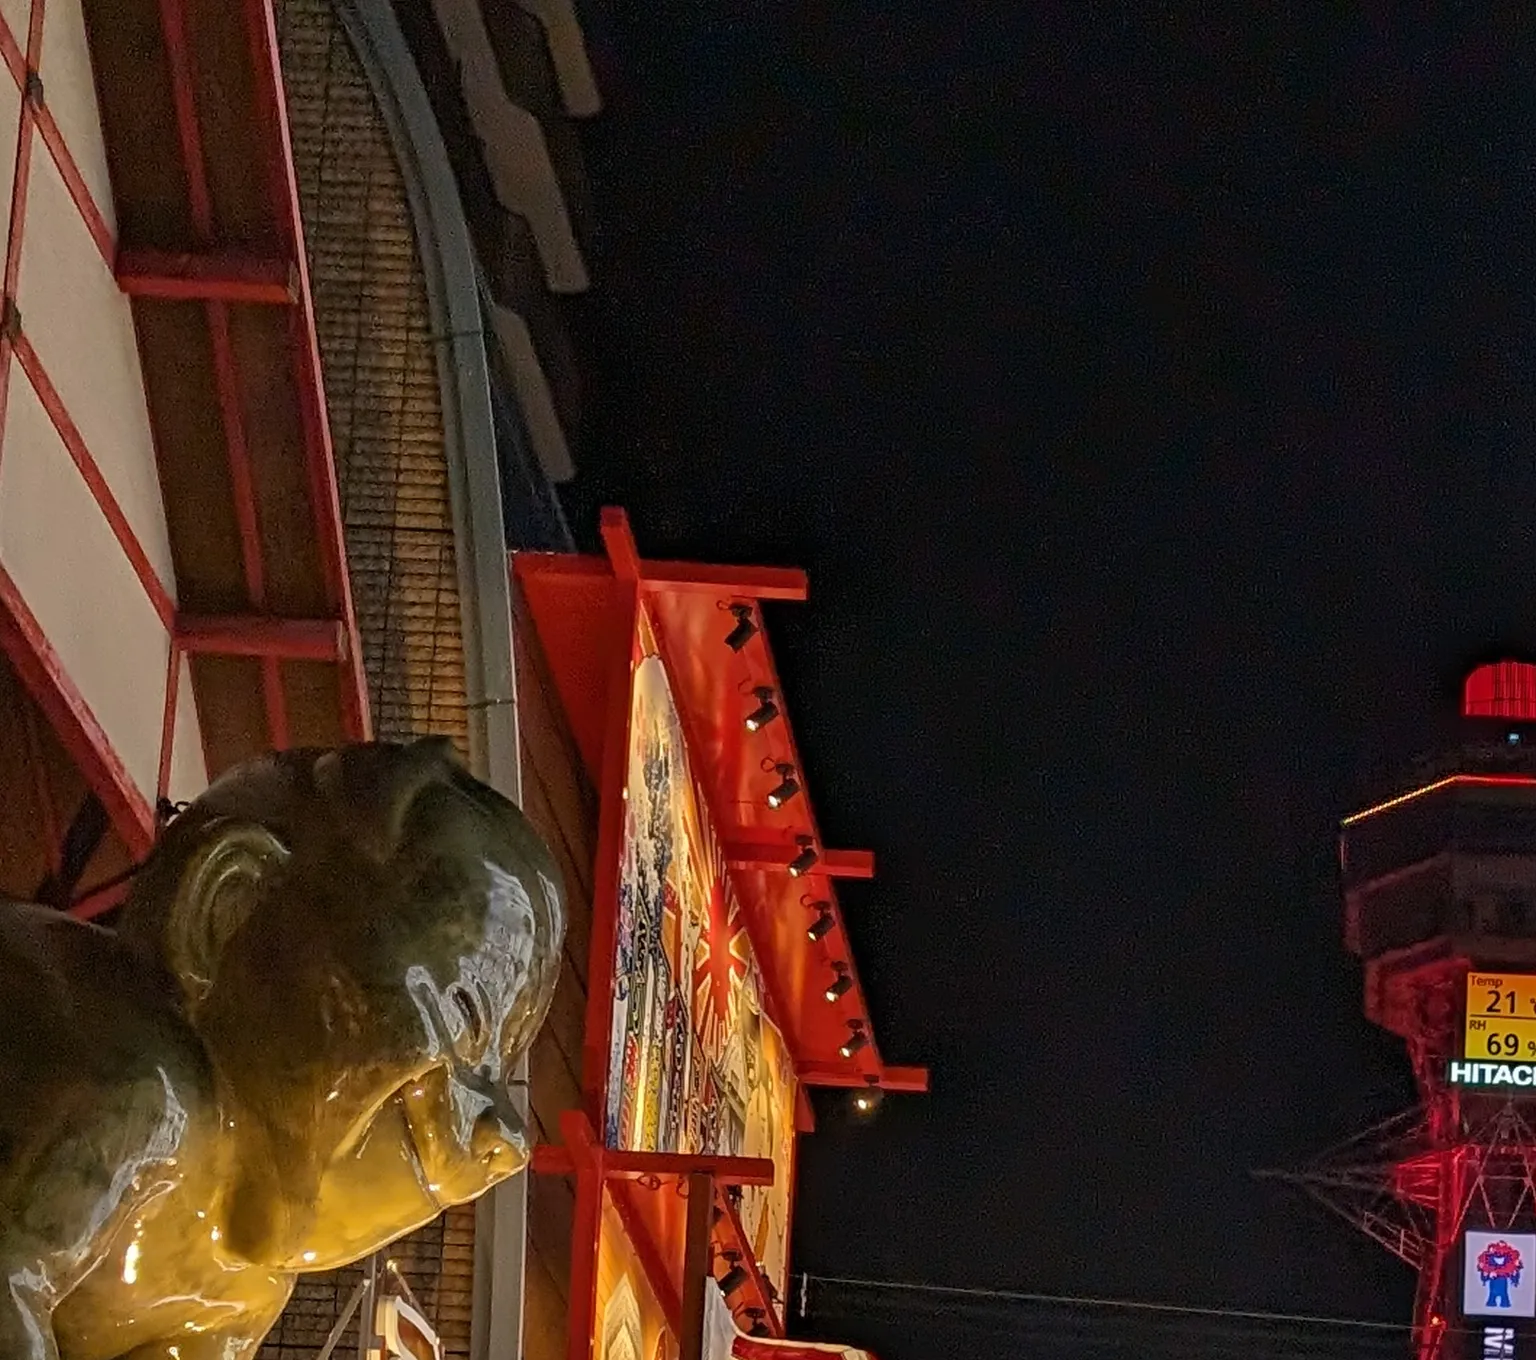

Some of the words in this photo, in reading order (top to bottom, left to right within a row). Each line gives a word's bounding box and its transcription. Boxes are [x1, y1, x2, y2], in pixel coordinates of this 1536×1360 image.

[1470, 975, 1503, 989] Temp
[1486, 990, 1516, 1014] 21
[1469, 1020, 1486, 1032] RH
[1486, 1032, 1518, 1057] 69
